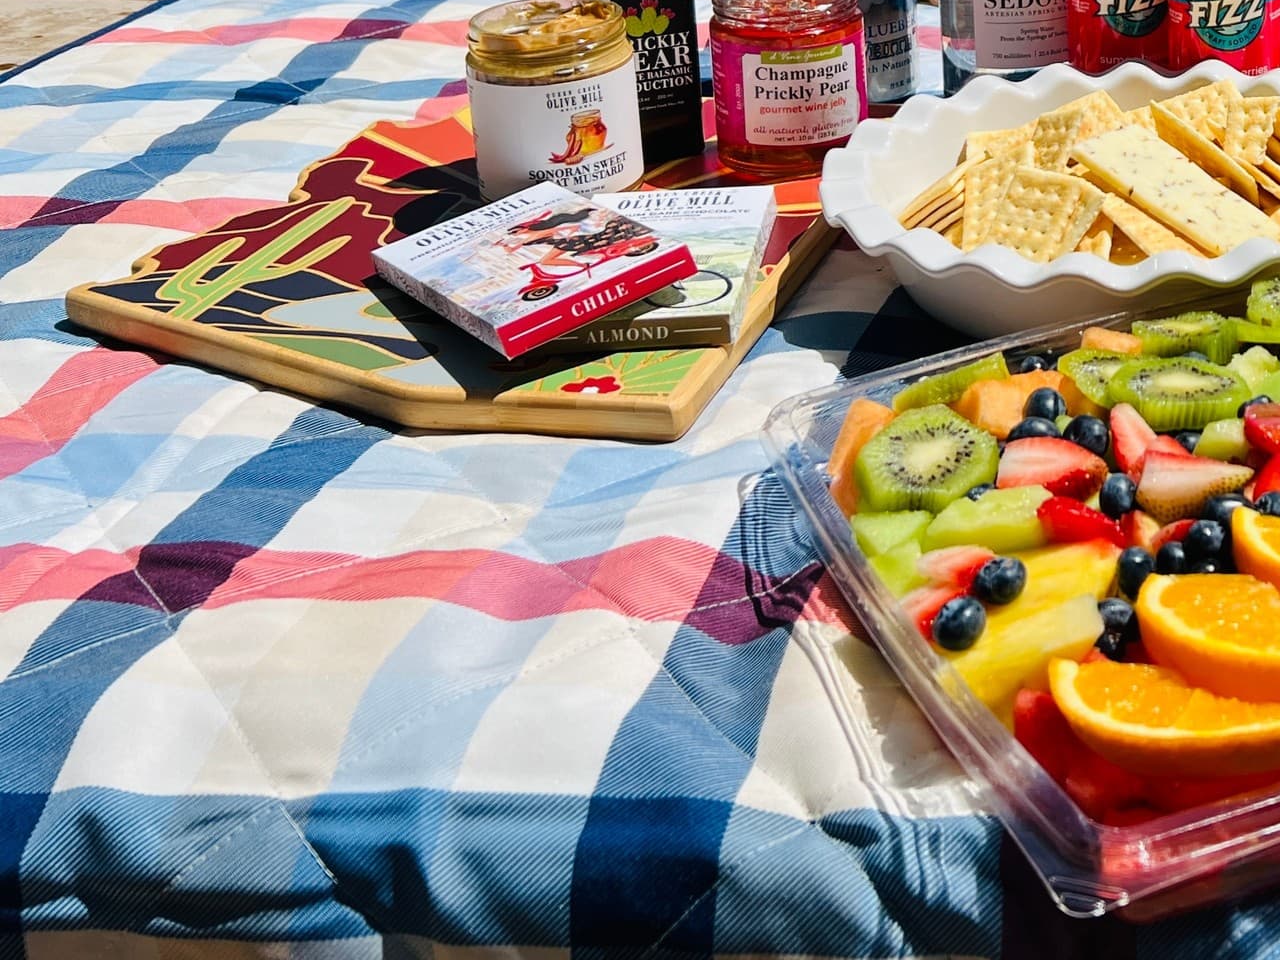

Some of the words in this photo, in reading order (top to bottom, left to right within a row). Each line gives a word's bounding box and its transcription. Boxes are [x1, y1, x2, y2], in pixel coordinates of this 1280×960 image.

[631, 30, 691, 52] ICKLY
[634, 45, 693, 73] EAR
[647, 66, 692, 80] BALSAMIC
[754, 61, 848, 82] Champagne
[547, 96, 577, 109] OLIVE
[582, 91, 604, 104] MILL
[754, 85, 814, 102] Prickly
[820, 79, 850, 96] Pear
[759, 104, 802, 114] gourmet
[805, 101, 828, 111] wine
[830, 96, 847, 110] jelly
[528, 164, 591, 181] SONORAN
[594, 151, 627, 172] SWEET
[573, 163, 624, 186] MUSTARD
[617, 198, 679, 210] OLIVE
[689, 195, 735, 205] MILL
[416, 220, 481, 247] OLIVE
[483, 197, 537, 218] MILL
[571, 282, 629, 318] CHILE
[586, 326, 669, 344] ALMOND
